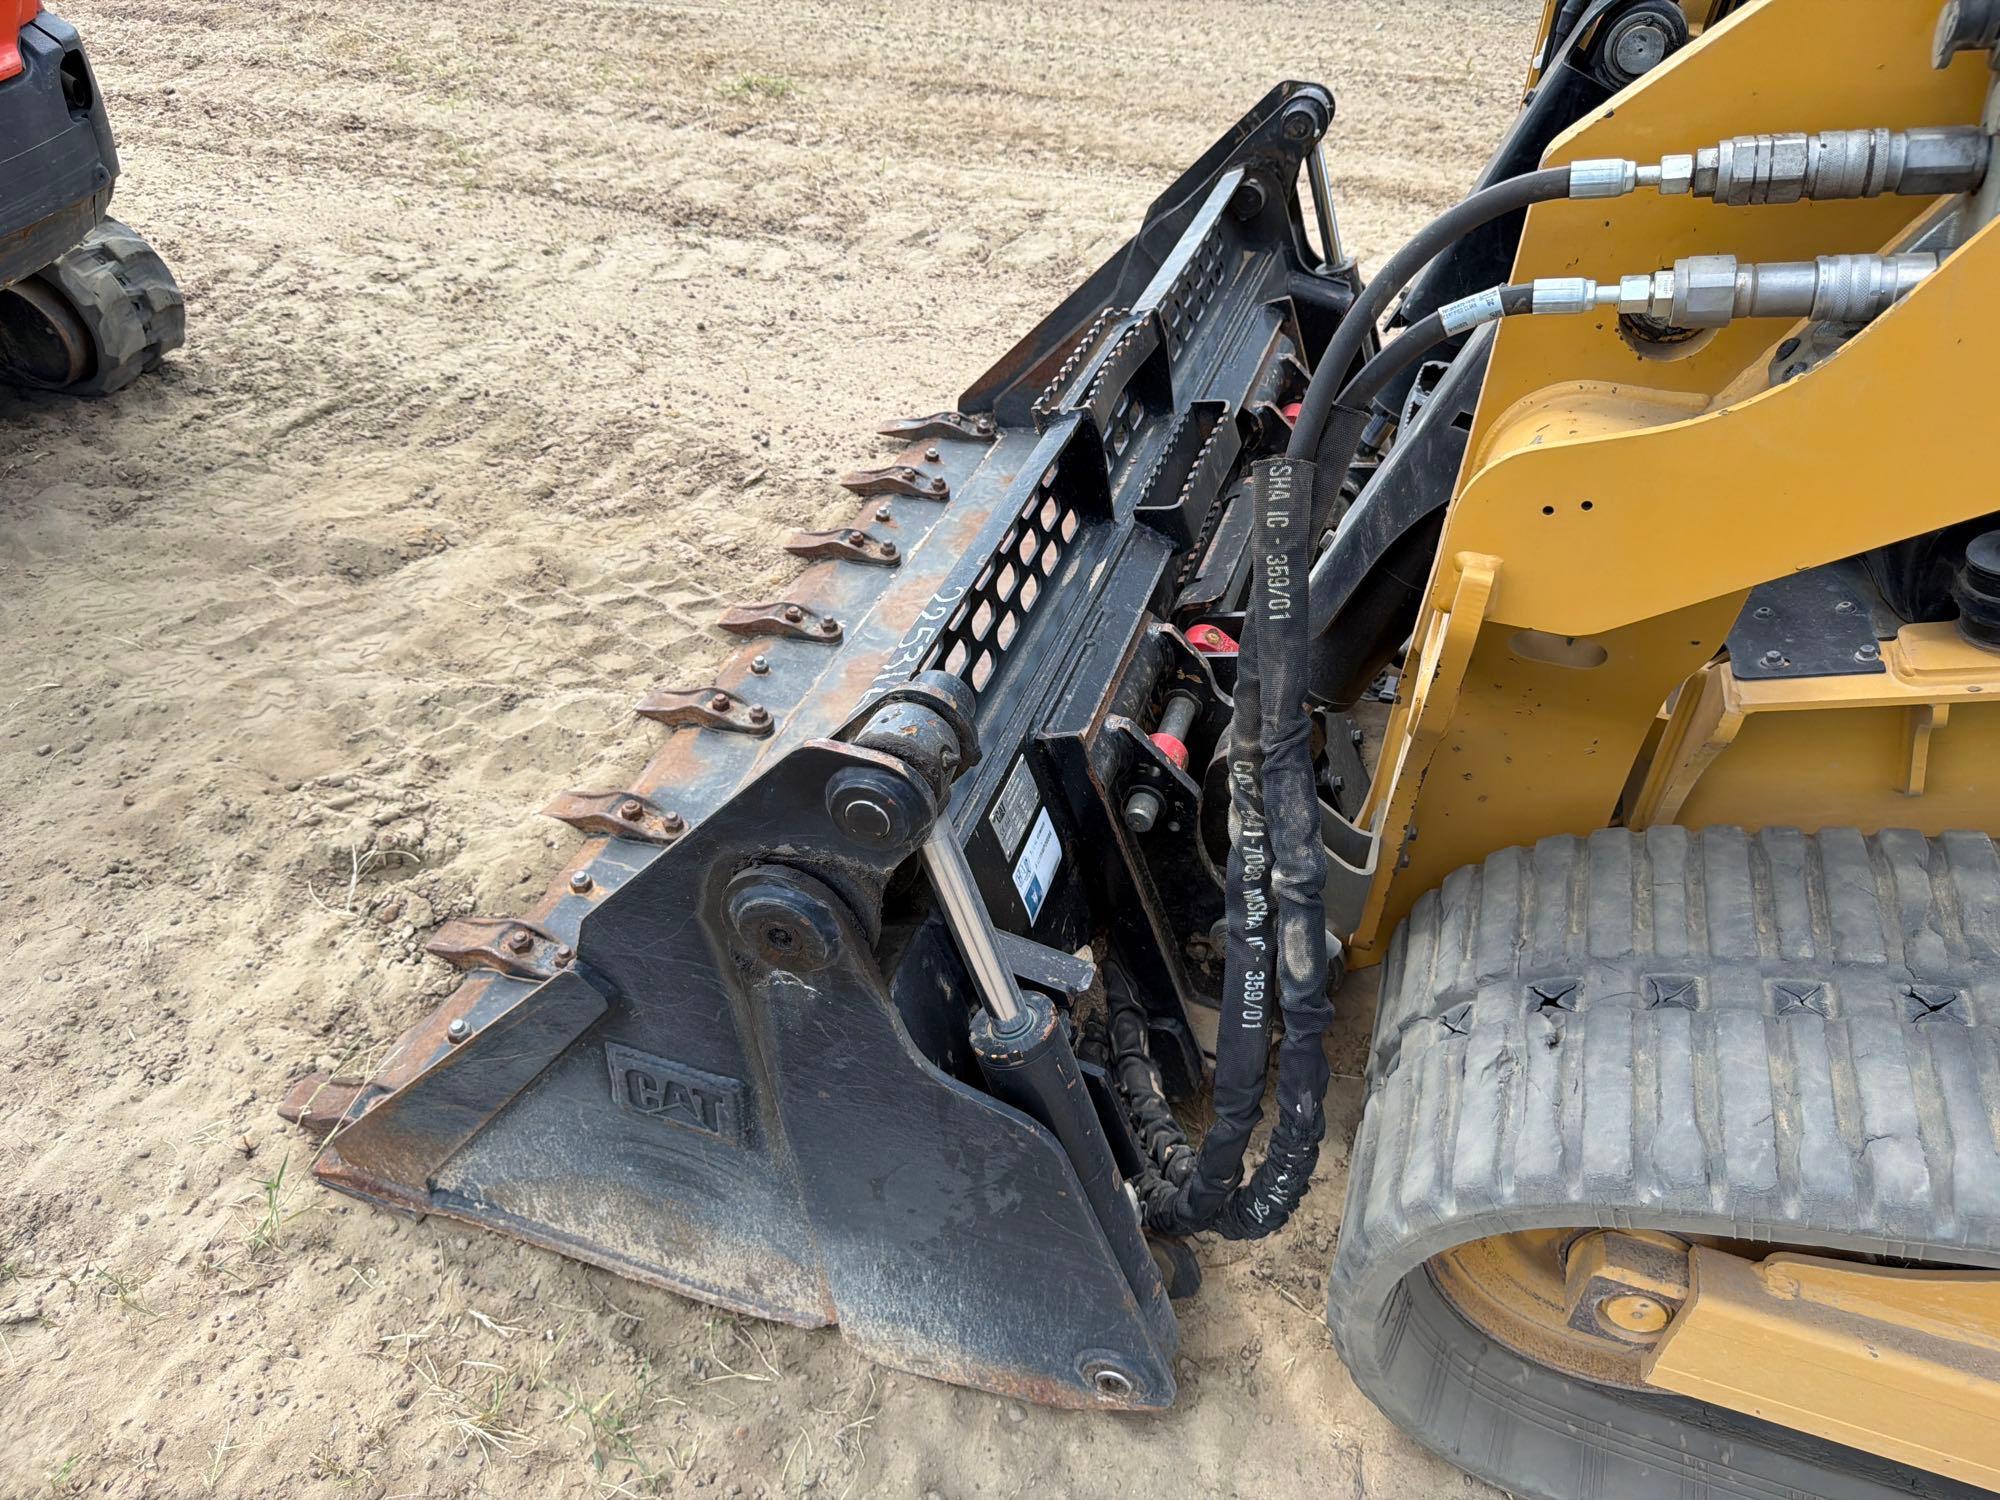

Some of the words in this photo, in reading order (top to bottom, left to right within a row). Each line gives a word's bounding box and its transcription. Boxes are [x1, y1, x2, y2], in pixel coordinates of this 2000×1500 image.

[1266, 511, 1290, 528] IC
[1266, 553, 1292, 620] 359/01
[1242, 887, 1268, 931] MSHA
[1241, 970, 1265, 1029] 359/01
[625, 1069, 724, 1133] CAT
